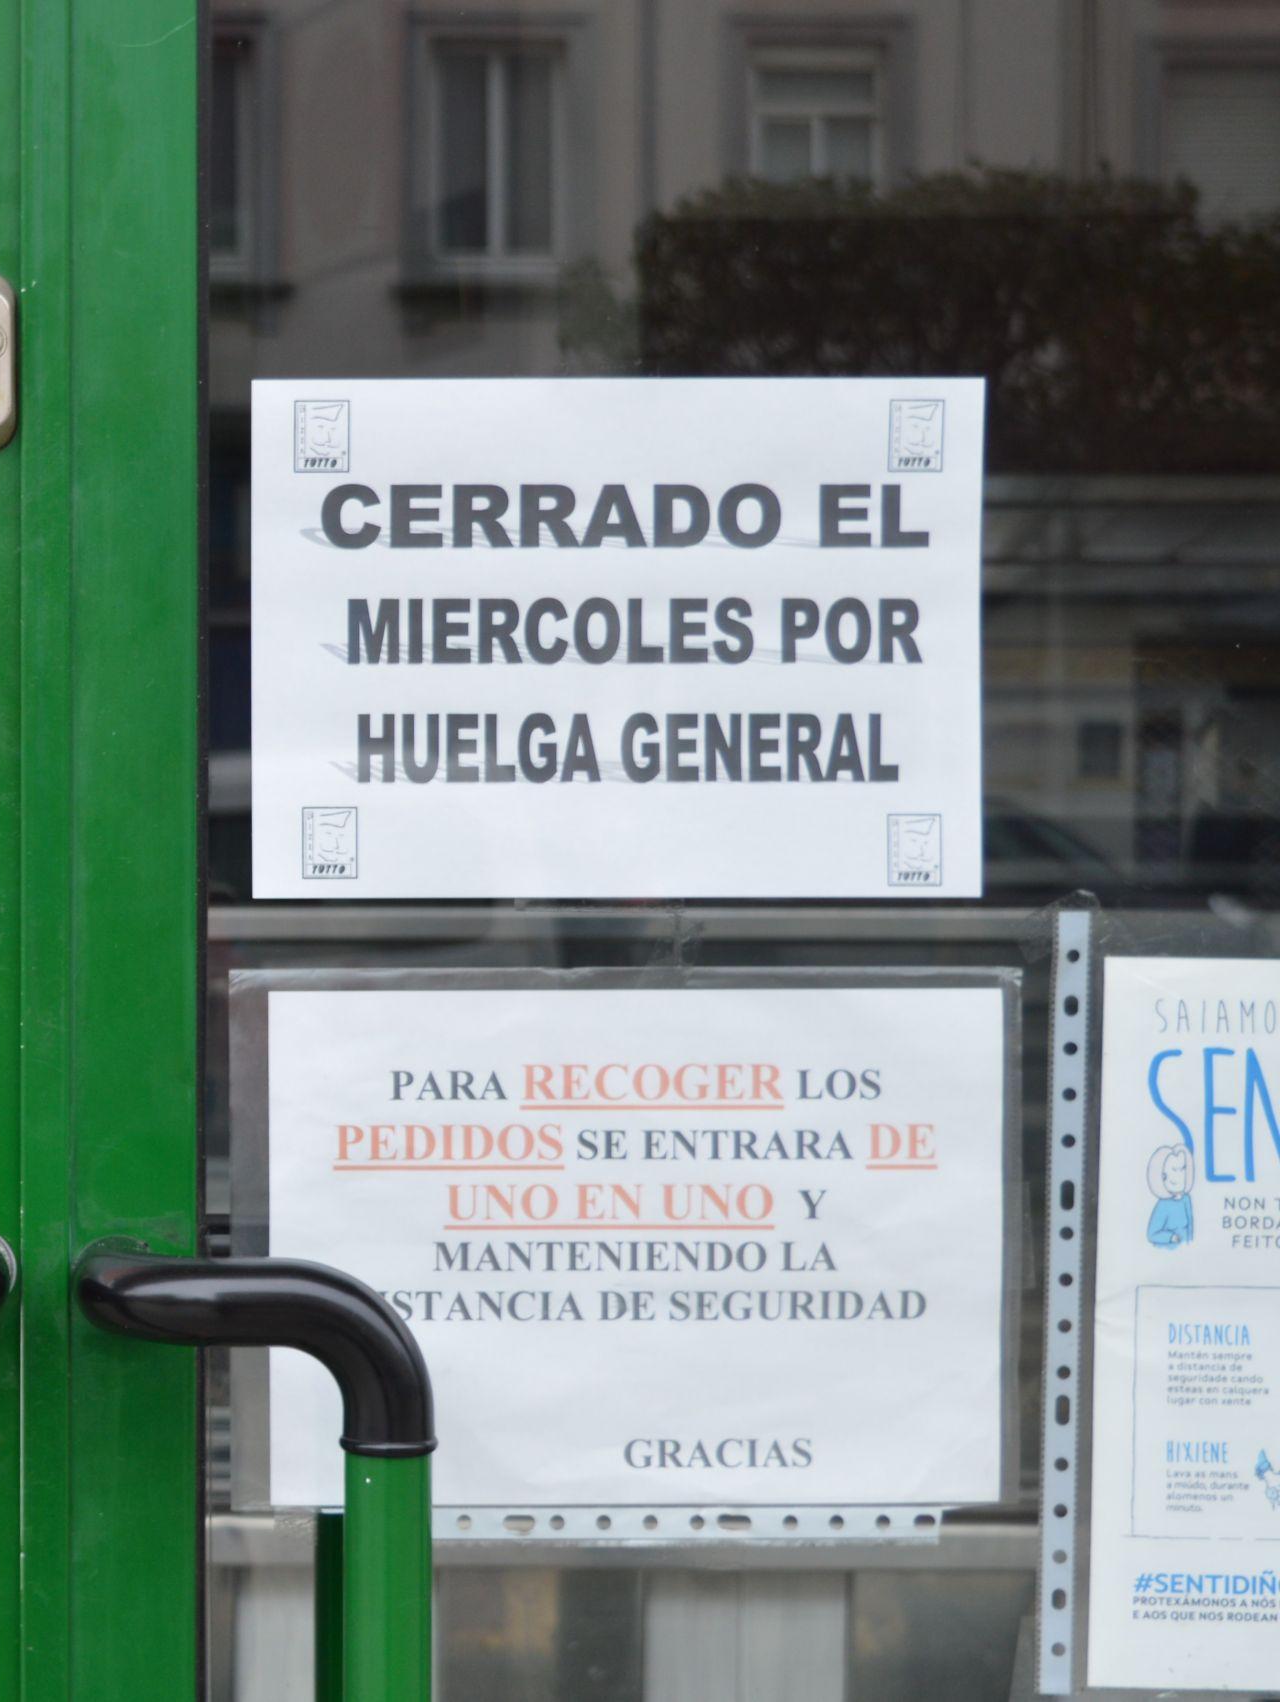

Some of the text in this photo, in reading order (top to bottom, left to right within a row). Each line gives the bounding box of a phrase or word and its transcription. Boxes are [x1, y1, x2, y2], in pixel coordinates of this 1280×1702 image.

[320, 483, 930, 549] CERRADO EL
[347, 597, 923, 665] MIERCOLES POR
[357, 712, 899, 784] HUELGA GENERAL
[1154, 998, 1277, 1034] SAIAMO
[390, 1063, 881, 1103] PARA RECOGER LOS
[334, 1122, 937, 1163] PEDIDOS SE ENTRARA DE
[447, 1182, 827, 1222] UNO EN UNO Y
[1224, 1196, 1265, 1210] NON
[433, 1241, 837, 1273] MANTENIENDO LA
[376, 1288, 927, 1322] STANCIA DE SEGURIDAD
[1168, 1323, 1252, 1346] DISTANCIA
[623, 1438, 813, 1471] GRACIAS
[1166, 1440, 1228, 1463] HIXIENE
[1133, 1570, 1280, 1595] #SENTIDIÑ
[1170, 1611, 1195, 1623] QUE
[1199, 1611, 1224, 1622] NOS
[1227, 1612, 1278, 1623] RODEAN
